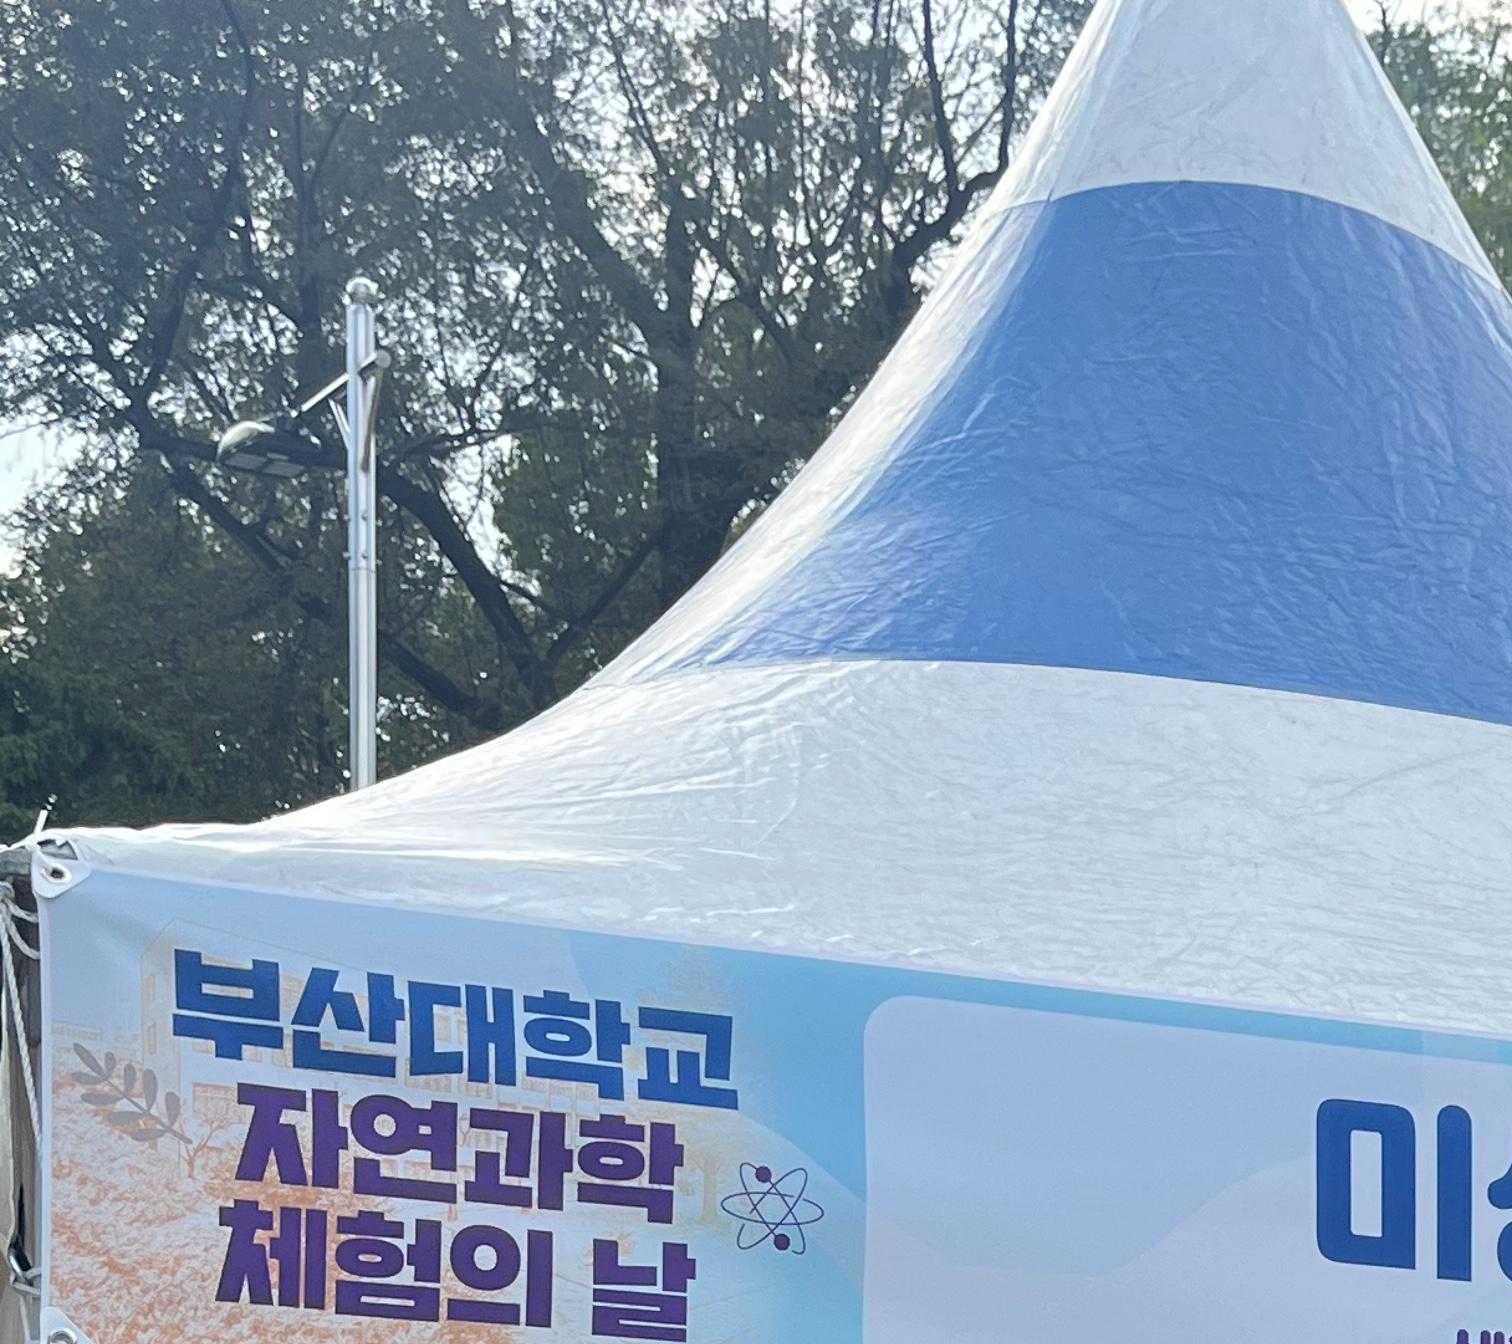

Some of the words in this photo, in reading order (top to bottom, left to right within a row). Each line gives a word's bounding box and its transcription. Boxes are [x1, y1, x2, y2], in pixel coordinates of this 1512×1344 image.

[172, 948, 739, 1111] 부산대학교
[235, 1082, 684, 1224] 자연과학
[215, 1199, 553, 1329] 체험의
[591, 1238, 697, 1343] 날
